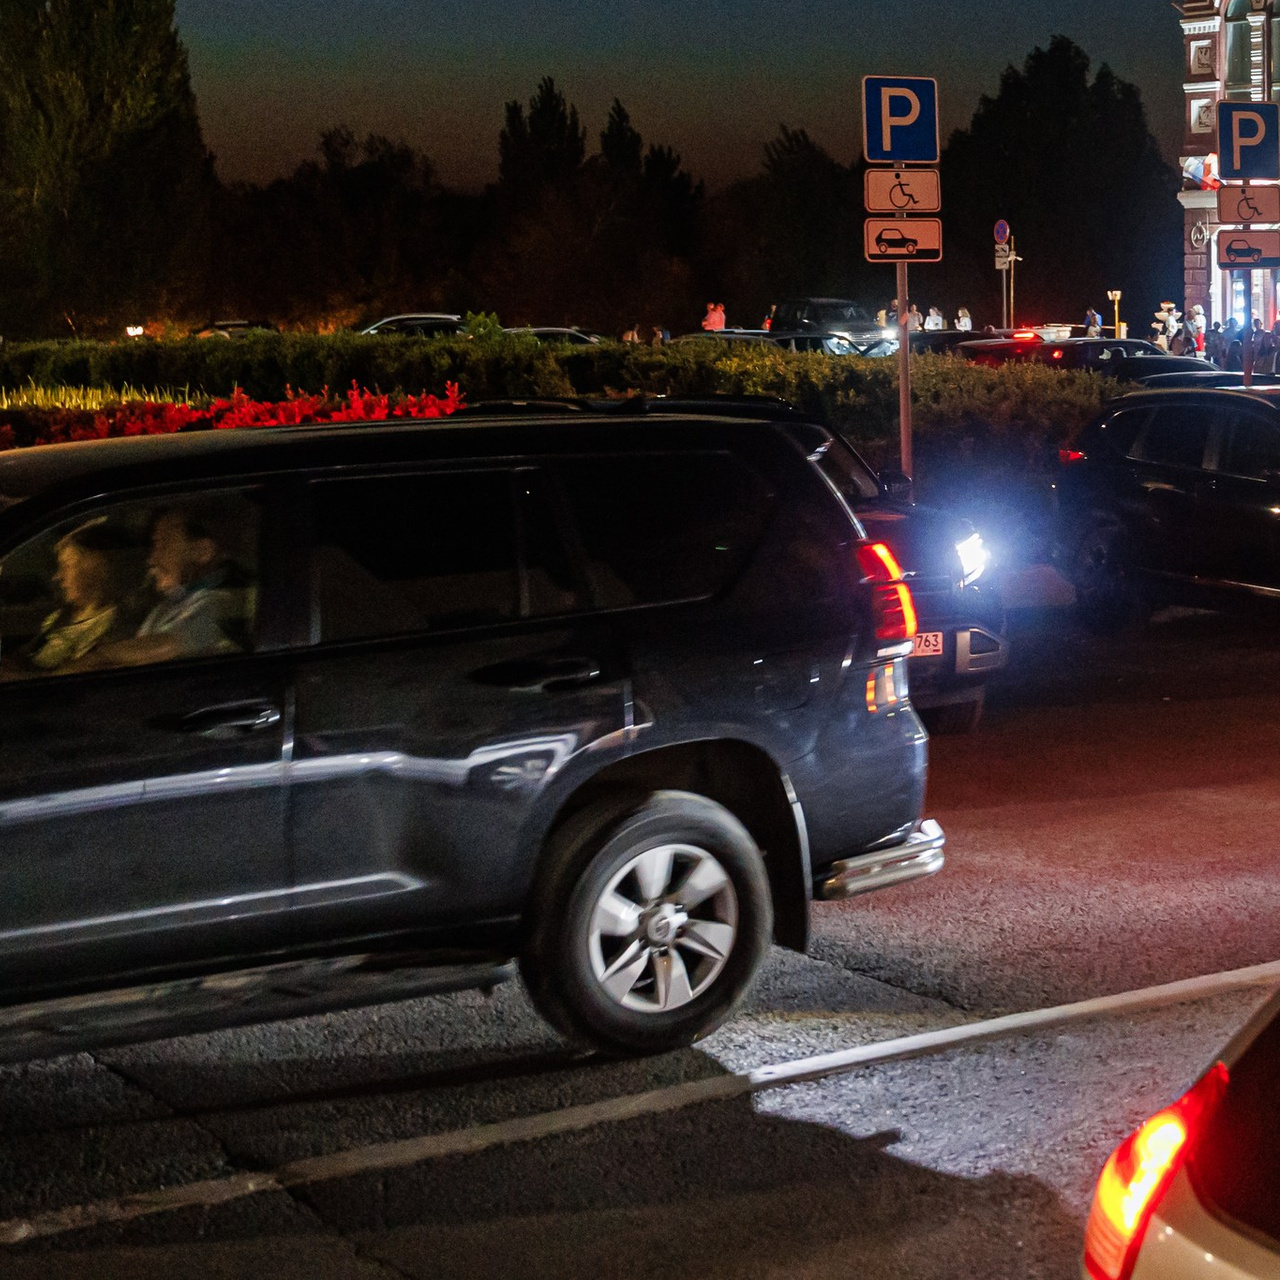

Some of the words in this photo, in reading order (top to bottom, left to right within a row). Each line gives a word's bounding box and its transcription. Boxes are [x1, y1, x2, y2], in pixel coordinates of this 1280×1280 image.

[881, 87, 921, 151] P
[1232, 111, 1266, 170] P
[917, 634, 939, 648] 763
